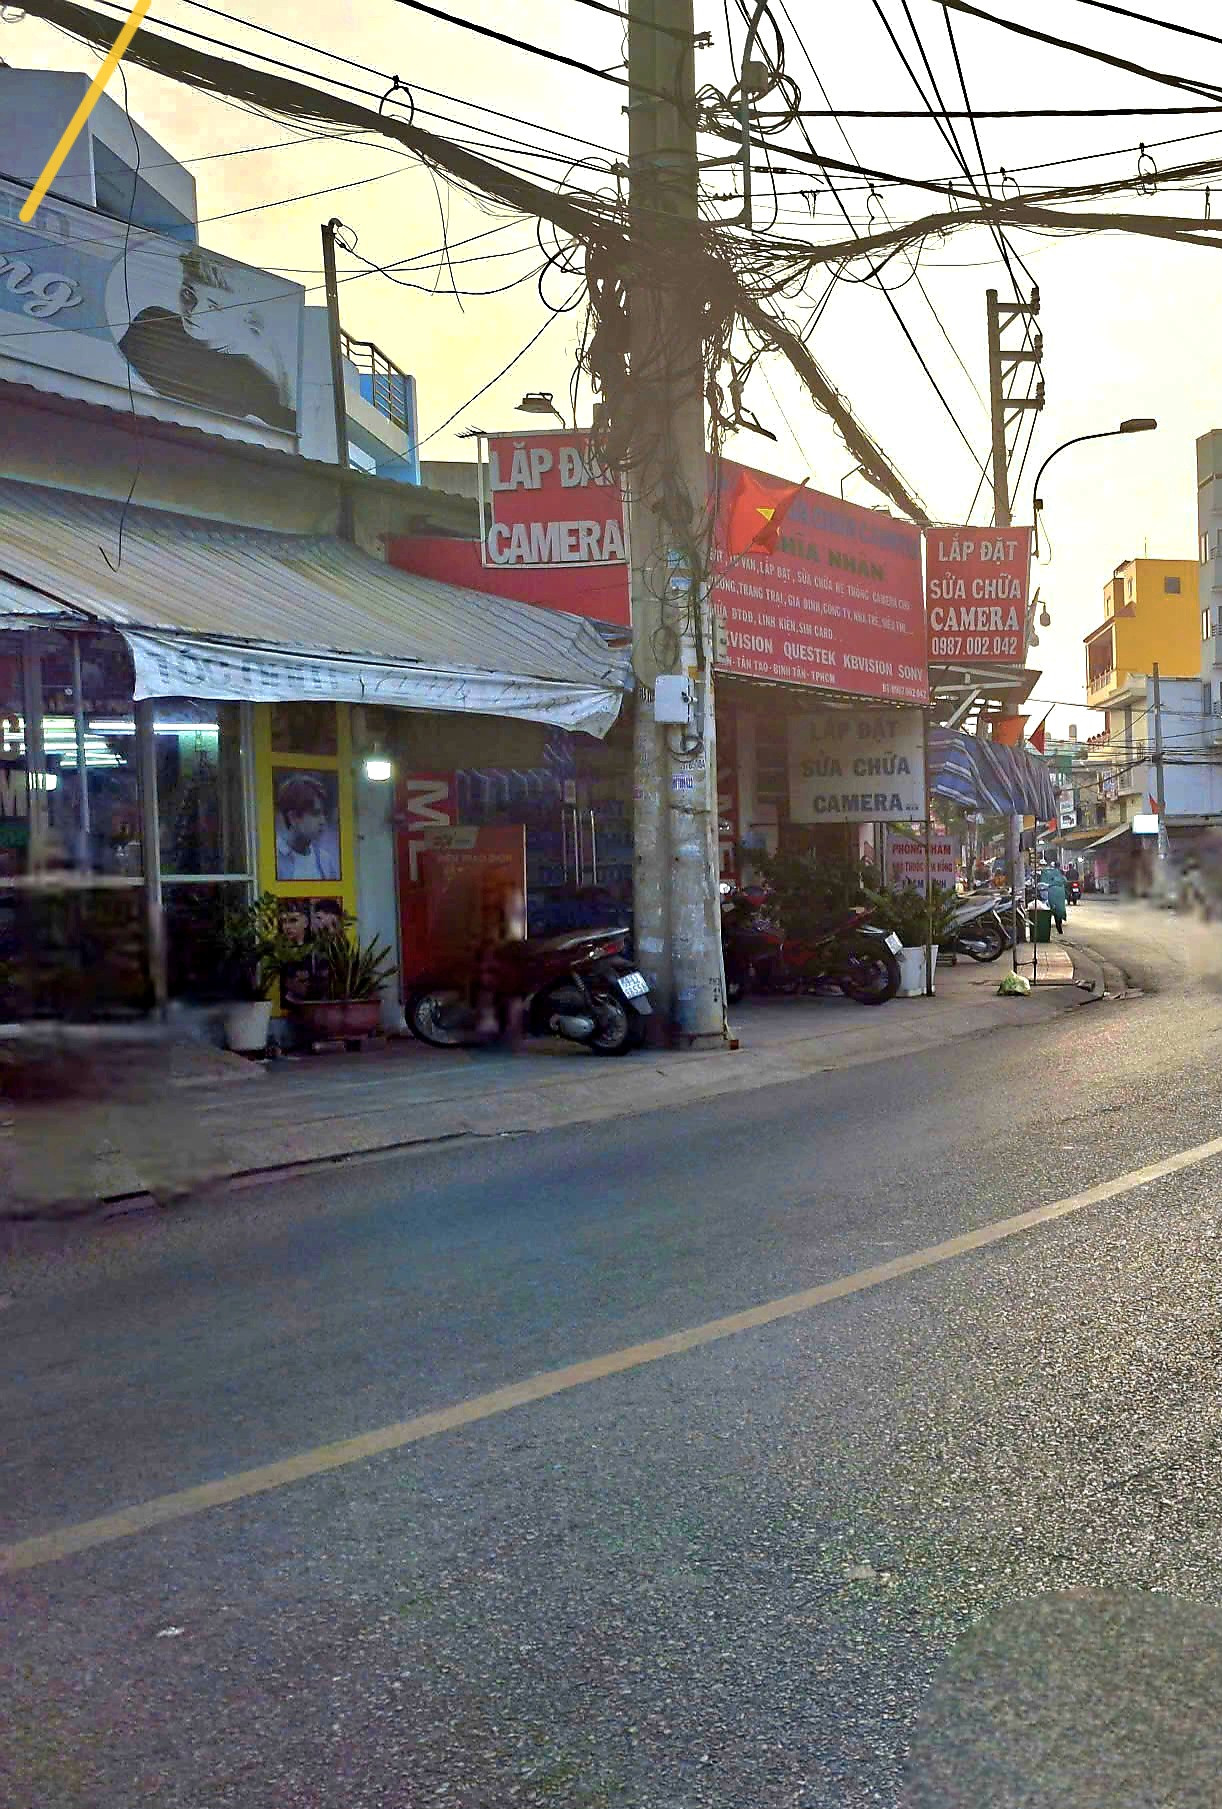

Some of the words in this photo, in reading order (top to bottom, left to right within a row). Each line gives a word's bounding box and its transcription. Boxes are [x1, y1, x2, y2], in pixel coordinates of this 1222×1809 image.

[489, 520, 625, 564] CAMERA
[938, 532, 975, 562] LẮP
[980, 537, 1018, 565] ĐẶT
[930, 571, 966, 599] SỬA
[972, 573, 1021, 599] CHỮA
[930, 606, 1020, 631] CAMERA
[931, 636, 1018, 656] 0987.002.042
[783, 641, 836, 666] QUESTEK
[843, 653, 893, 676] KBVISION
[898, 664, 924, 682] SONY
[853, 752, 911, 776] CHỮA
[926, 840, 951, 855] HÁM
